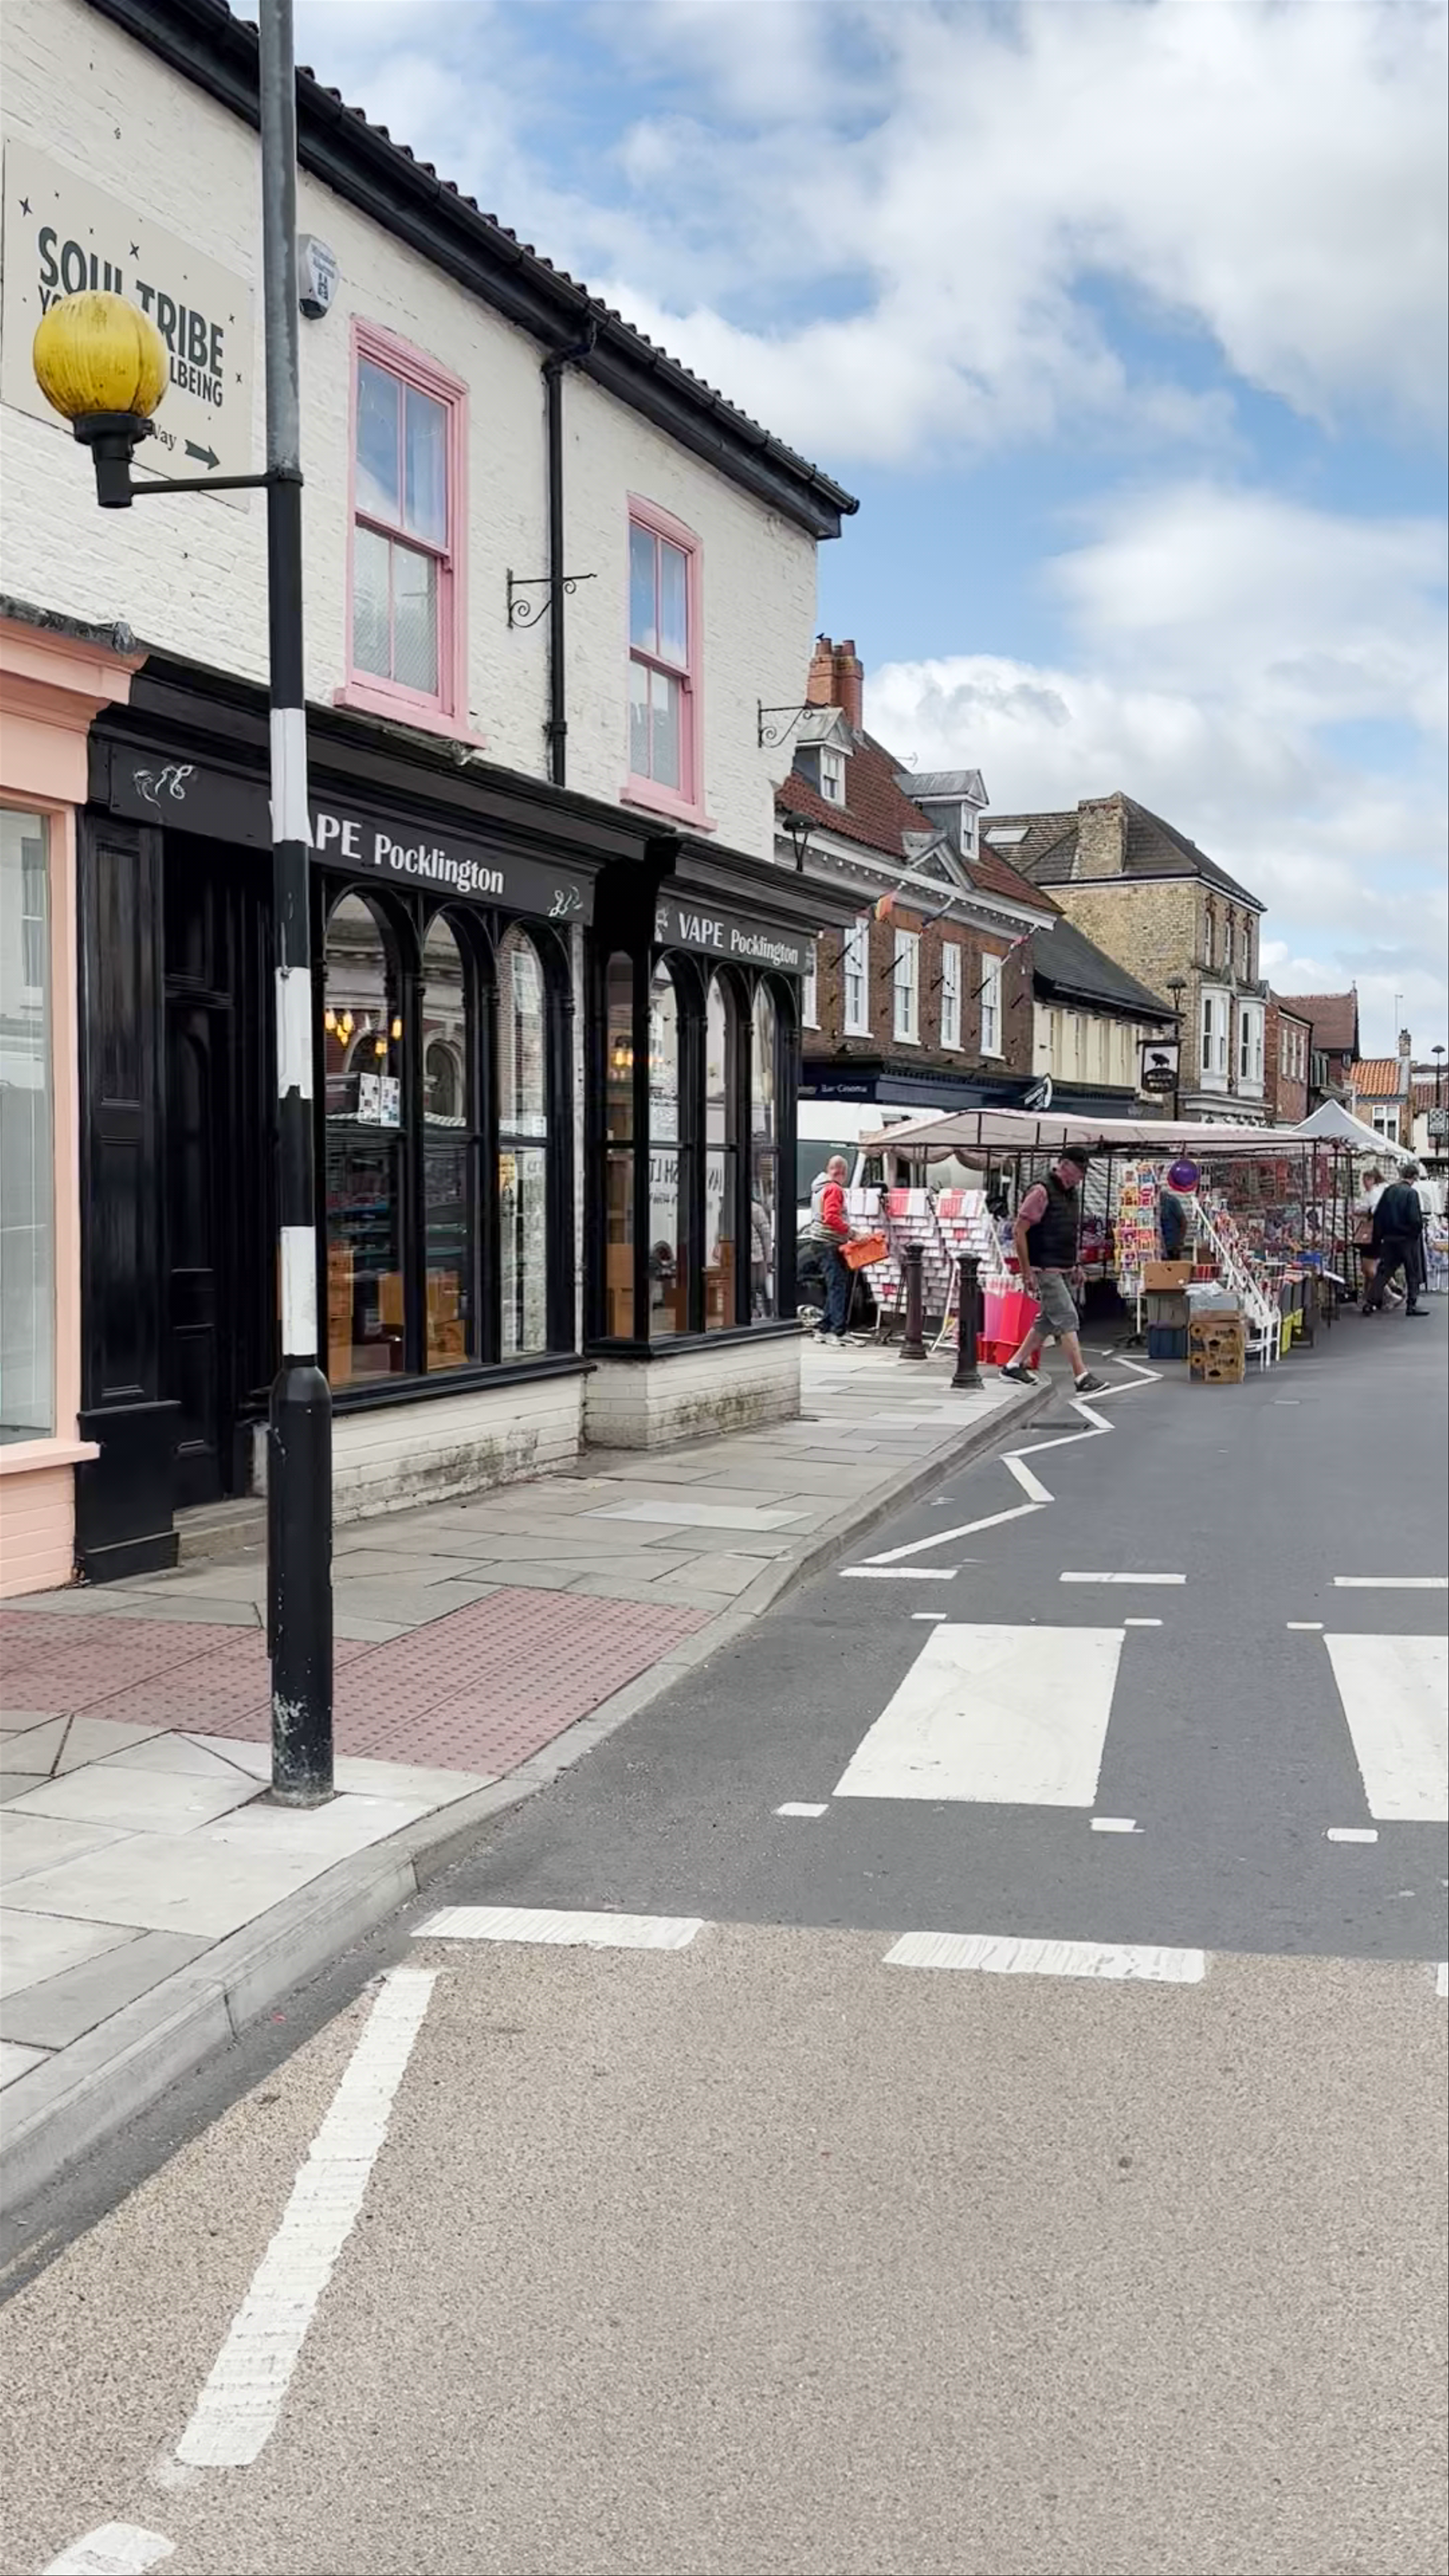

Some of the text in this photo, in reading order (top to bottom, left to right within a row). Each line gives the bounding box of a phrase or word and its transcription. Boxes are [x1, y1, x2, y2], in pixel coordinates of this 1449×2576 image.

[136, 280, 223, 378] TRIBE
[170, 356, 223, 408] LBEING
[300, 811, 503, 894] PE Pocklington
[679, 912, 798, 966] VAPE Pocklington
